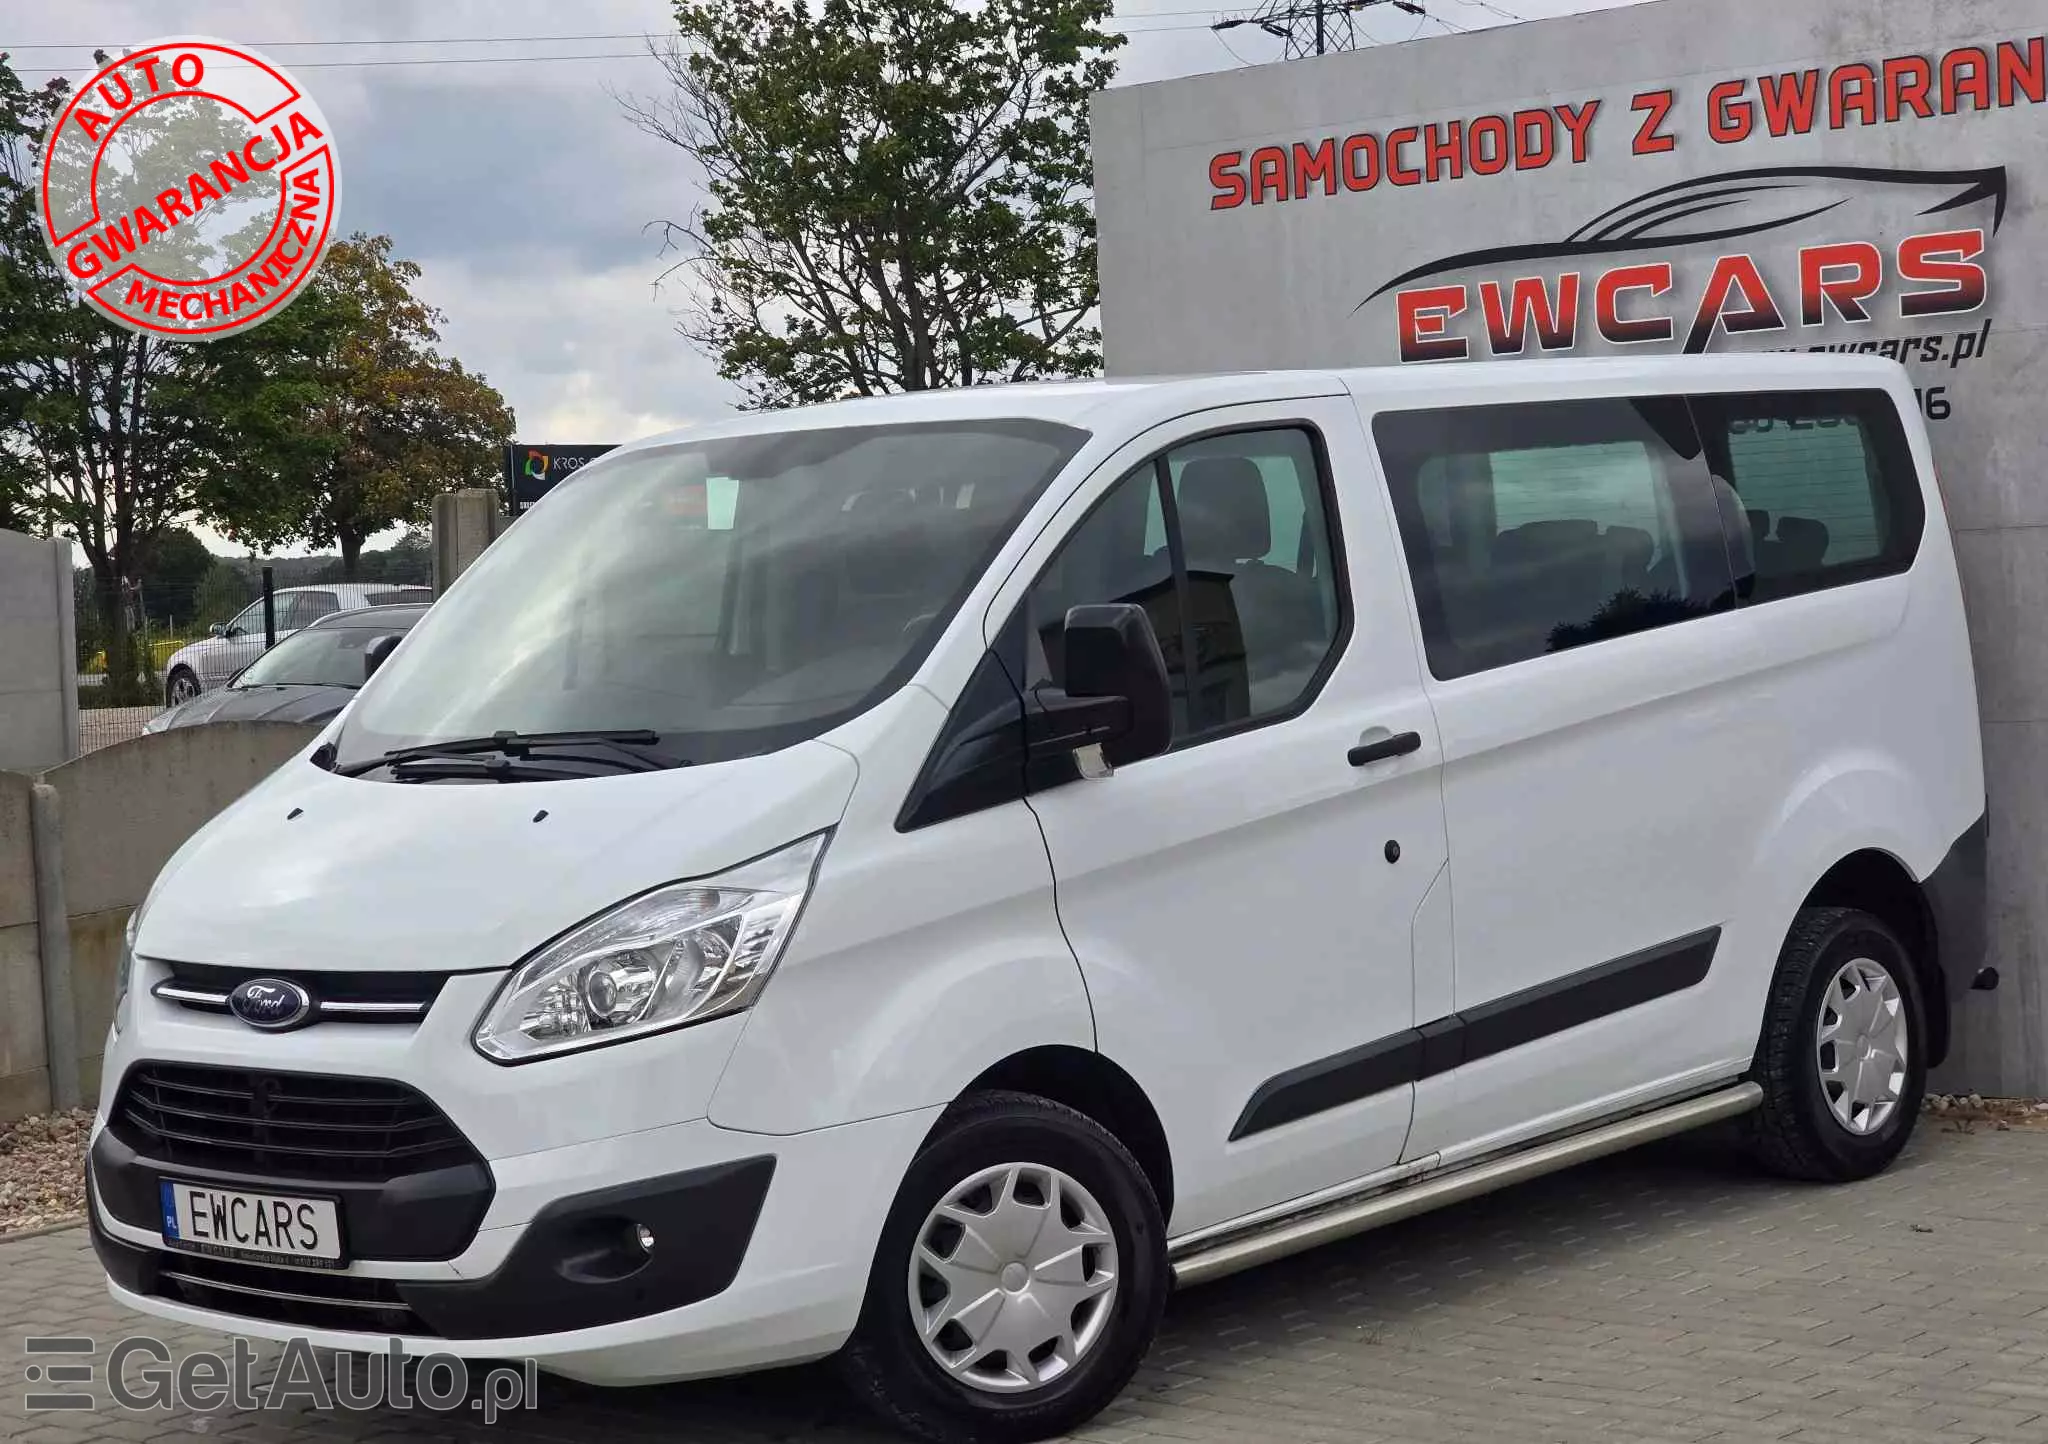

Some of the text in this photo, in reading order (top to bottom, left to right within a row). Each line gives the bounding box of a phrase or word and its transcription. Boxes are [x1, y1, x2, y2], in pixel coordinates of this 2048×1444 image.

[1209, 36, 2046, 210] SAMOCHODY Z GWARAN
[1396, 228, 1987, 363] EWCARS
[246, 985, 286, 1010] Ford
[189, 1190, 318, 1250] EWCARS
